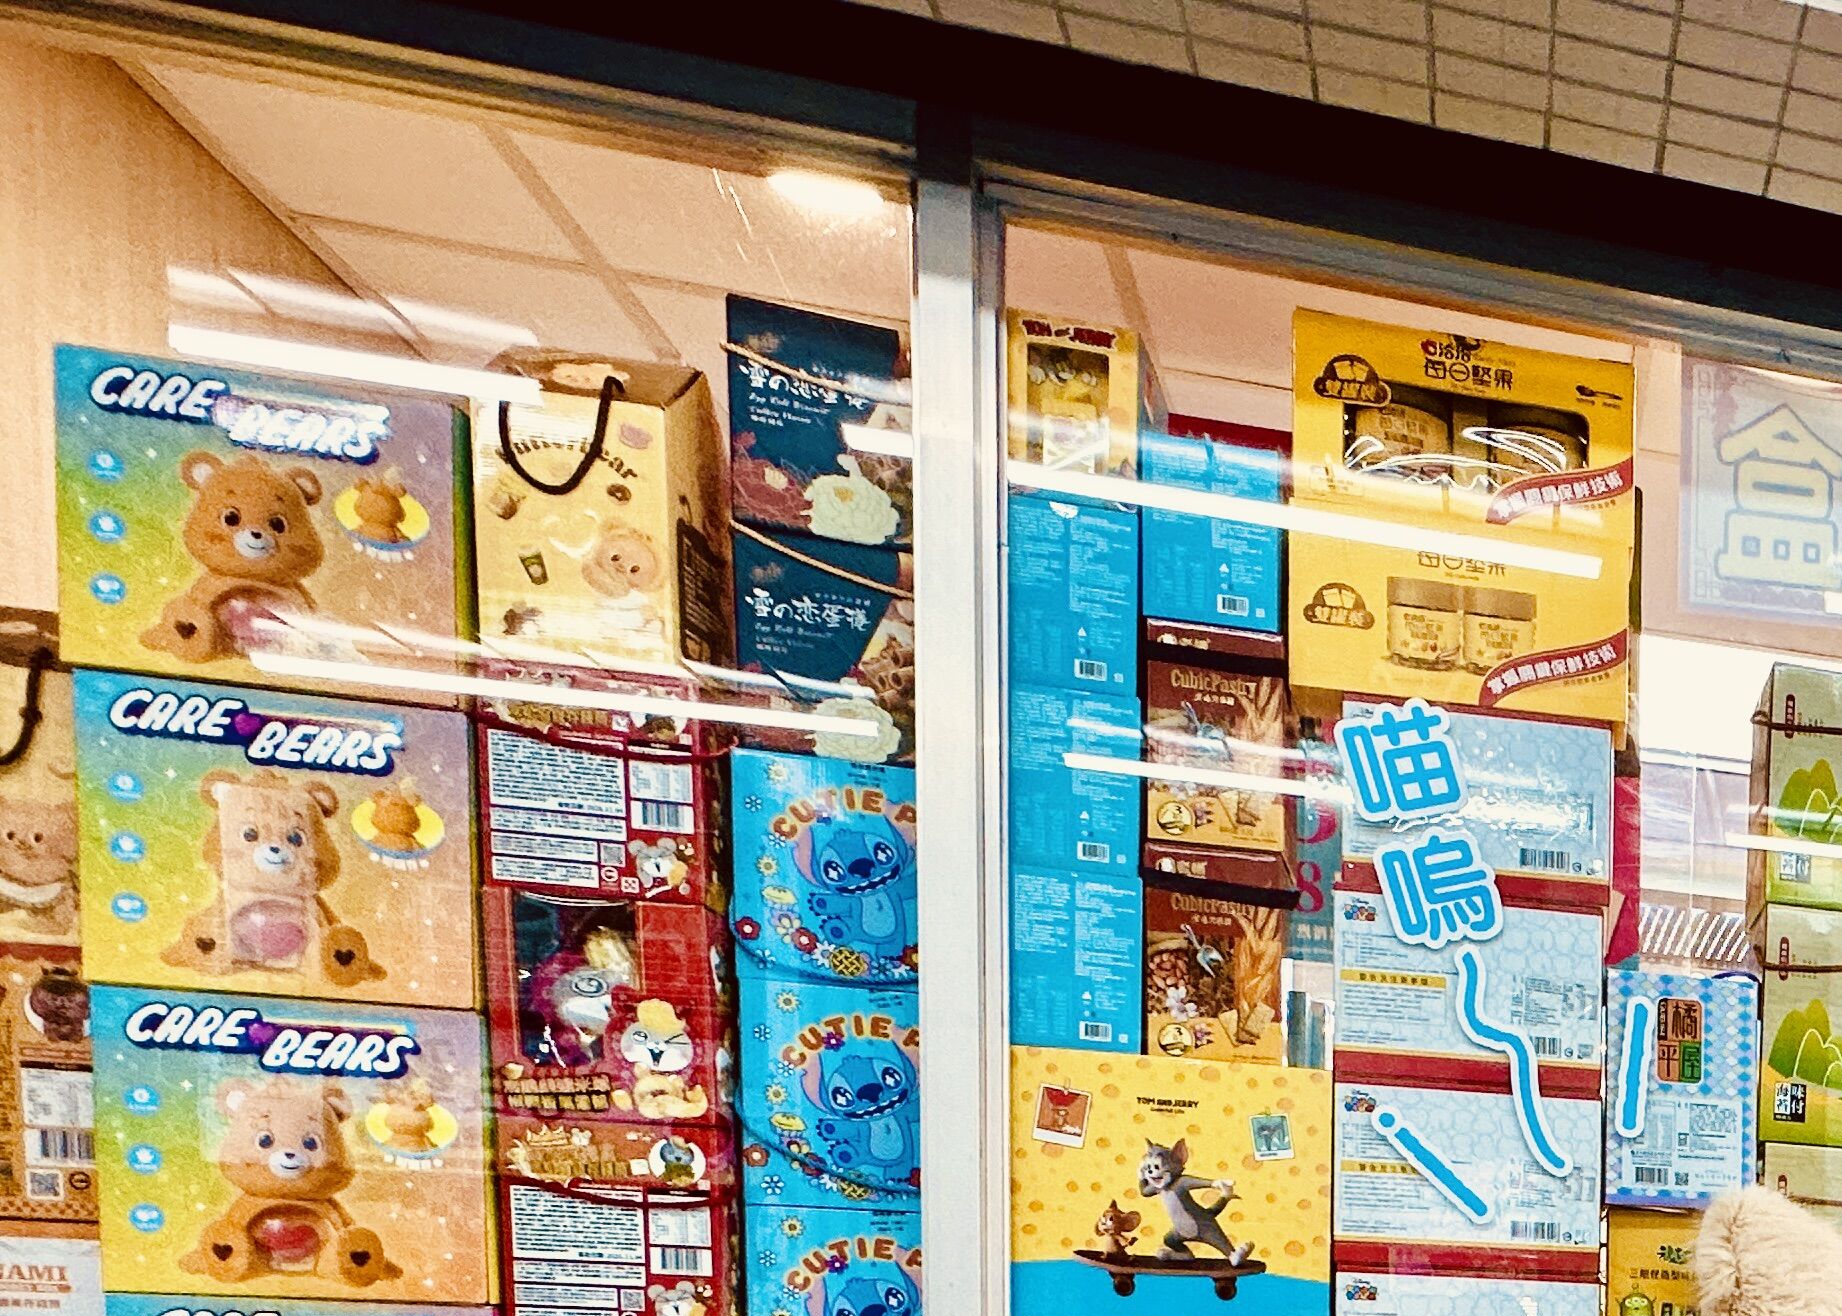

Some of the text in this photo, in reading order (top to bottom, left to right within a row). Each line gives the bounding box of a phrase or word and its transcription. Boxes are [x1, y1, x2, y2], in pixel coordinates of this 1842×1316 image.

[91, 366, 387, 461] CARE BEARS
[110, 688, 402, 771] CARE BEARS
[126, 1002, 413, 1075] CARE BEARS
[782, 1014, 892, 1067] CUTIE
[786, 1237, 895, 1291] CUTIE
